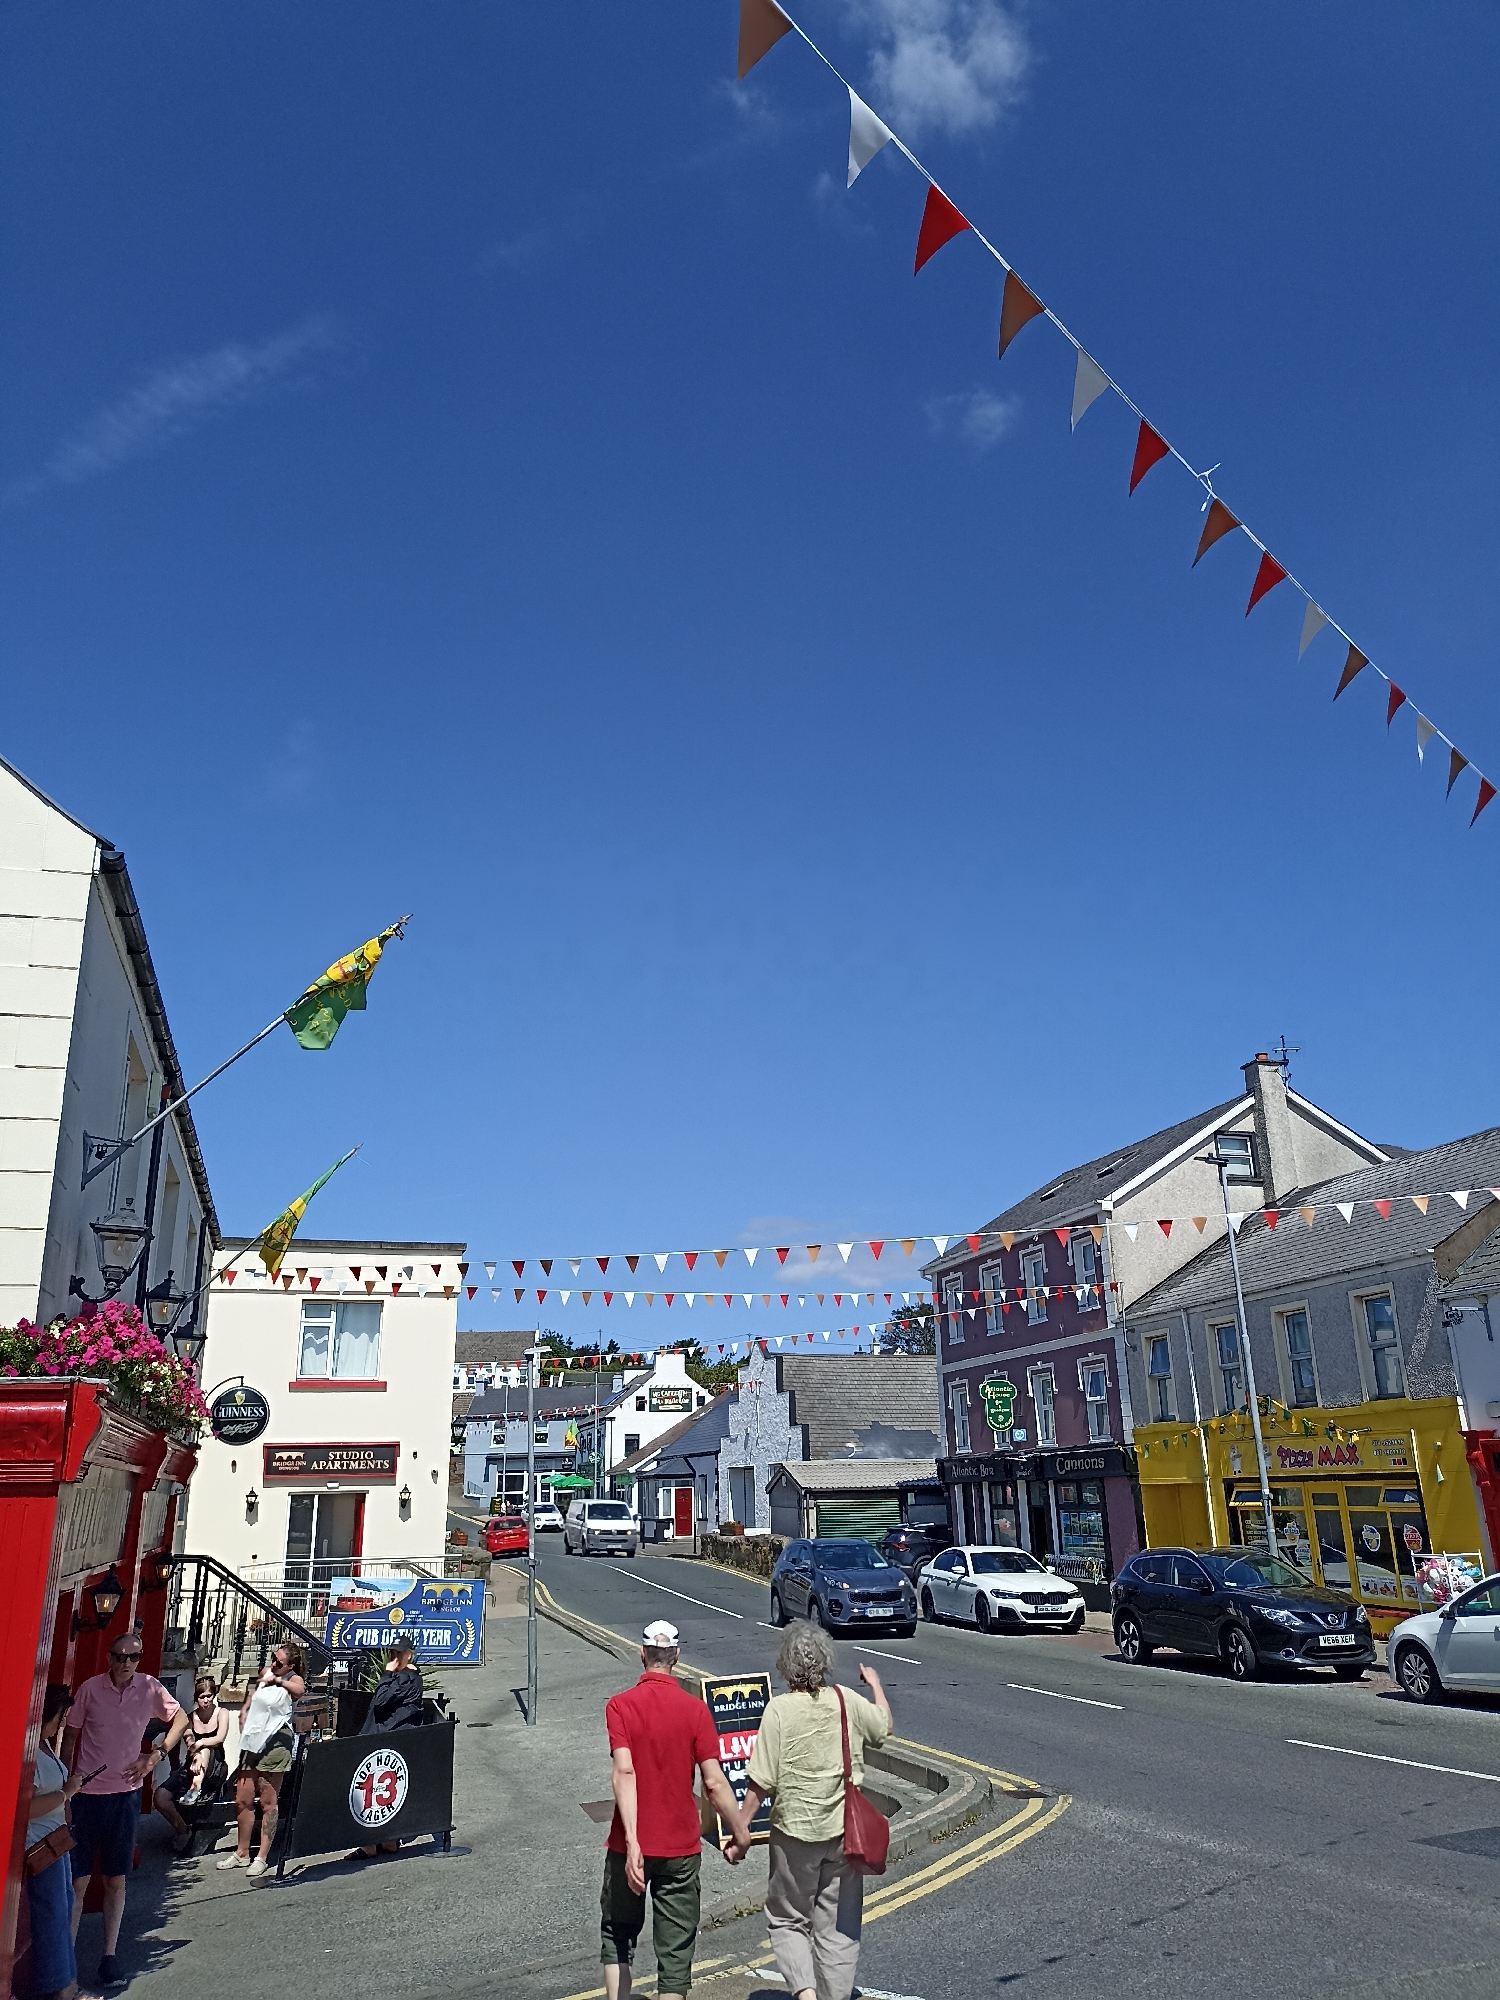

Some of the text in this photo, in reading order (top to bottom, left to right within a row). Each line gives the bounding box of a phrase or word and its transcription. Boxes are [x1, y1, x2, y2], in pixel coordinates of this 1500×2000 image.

[985, 1385, 1013, 1393] Atlantic
[987, 1391, 1011, 1399] House
[213, 1406, 265, 1418] GUINNESS
[328, 1450, 374, 1460] STUDIO
[1318, 1443, 1359, 1466] MAX
[311, 1460, 390, 1470] APARTMENTS
[951, 1465, 979, 1478] Atlantic
[1056, 1457, 1105, 1475] Cannons
[421, 1598, 473, 1606] BRIDGE INN
[354, 1628, 379, 1646] PUB
[381, 1628, 397, 1646] OF
[422, 1628, 452, 1646] YEAR
[713, 1700, 765, 1713] BRIDGE INN
[354, 1754, 405, 1790] HOP HOUSE
[363, 1770, 398, 1809] 13
[359, 1803, 396, 1822] LAGER
